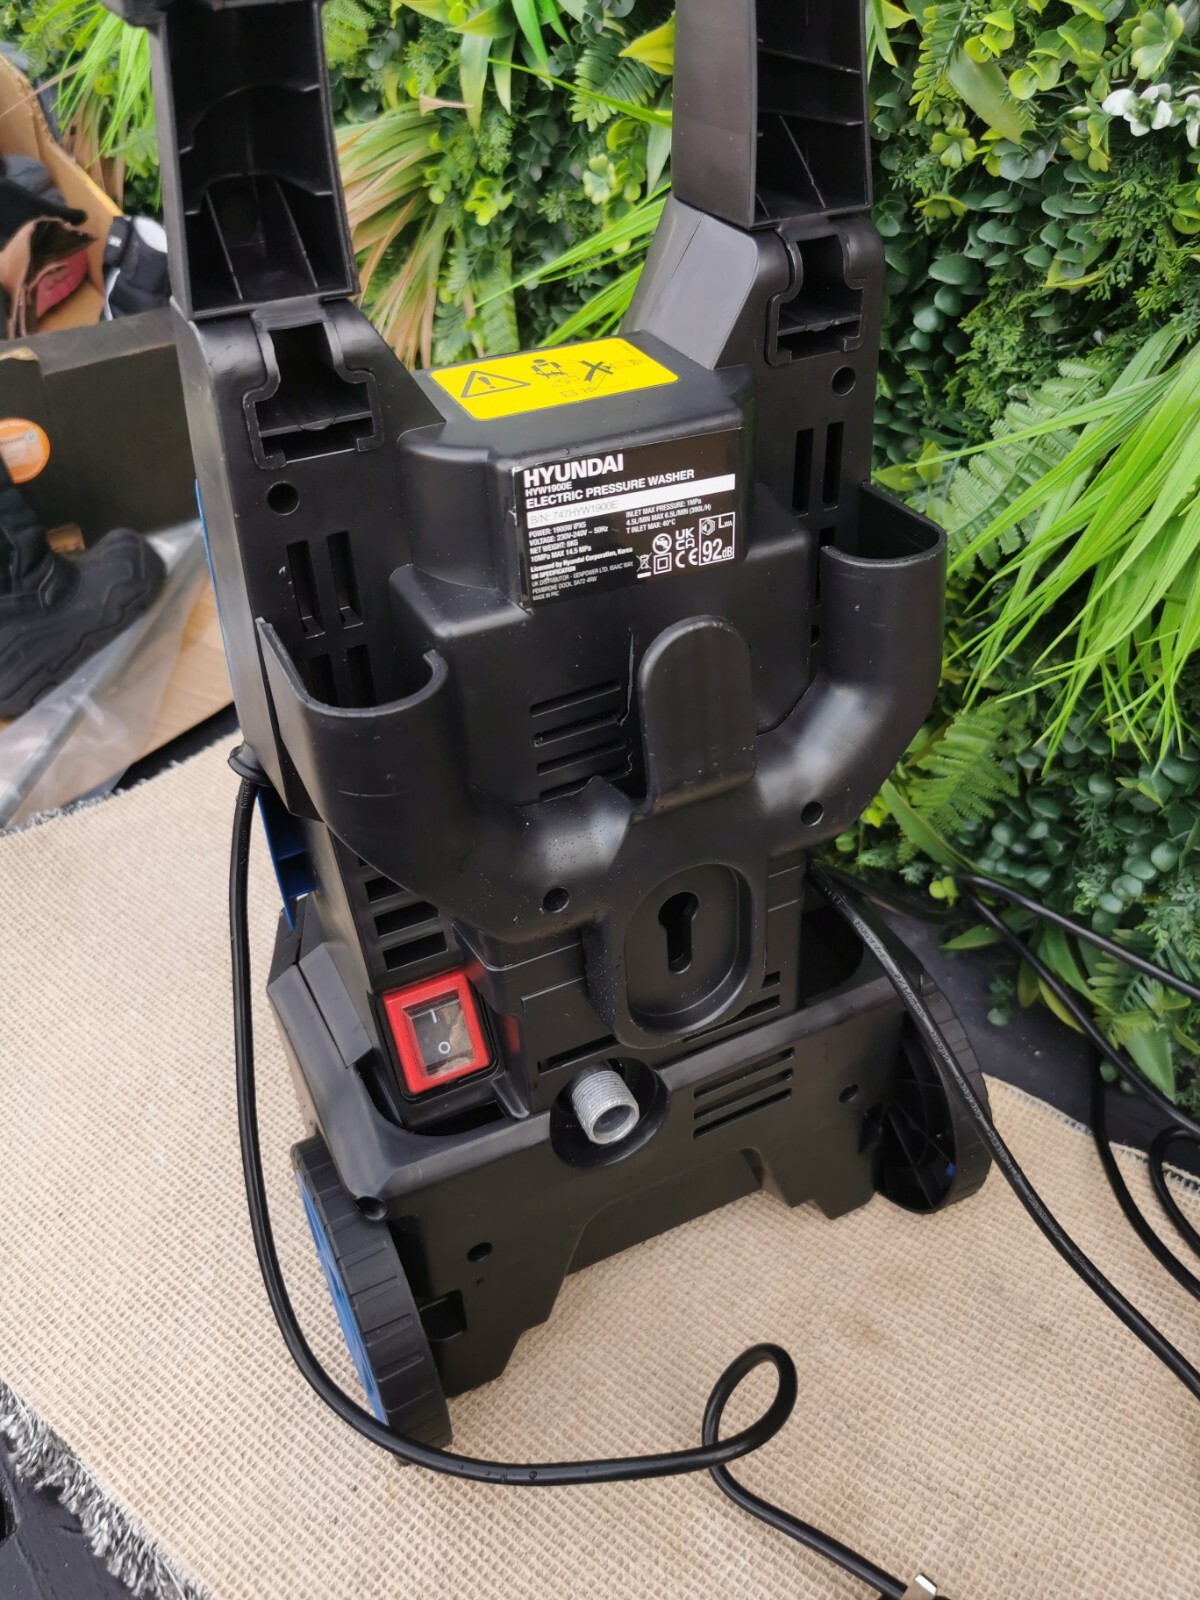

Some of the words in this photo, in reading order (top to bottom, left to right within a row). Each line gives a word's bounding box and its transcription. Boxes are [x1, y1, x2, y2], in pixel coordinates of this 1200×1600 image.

[524, 454, 624, 488] HYUNDAI
[525, 482, 572, 497] HYW1900E
[526, 490, 583, 509] ELECTRIC
[586, 478, 646, 498] PRESSURE
[648, 469, 695, 487] WASHER
[553, 500, 618, 520] 747HYW1900E
[626, 509, 641, 518] INLET
[643, 506, 655, 515] MAX
[656, 501, 685, 512] PRESSURE:
[652, 513, 664, 521] MAX
[529, 528, 552, 538] POWER:
[631, 525, 647, 533] INLET
[529, 536, 556, 546] VOLTAGE:
[542, 542, 566, 552] WEIGHT:
[551, 550, 564, 558] MAX
[579, 545, 592, 553] MPa
[530, 562, 554, 572] Licensed
[563, 556, 584, 566] Hyundai
